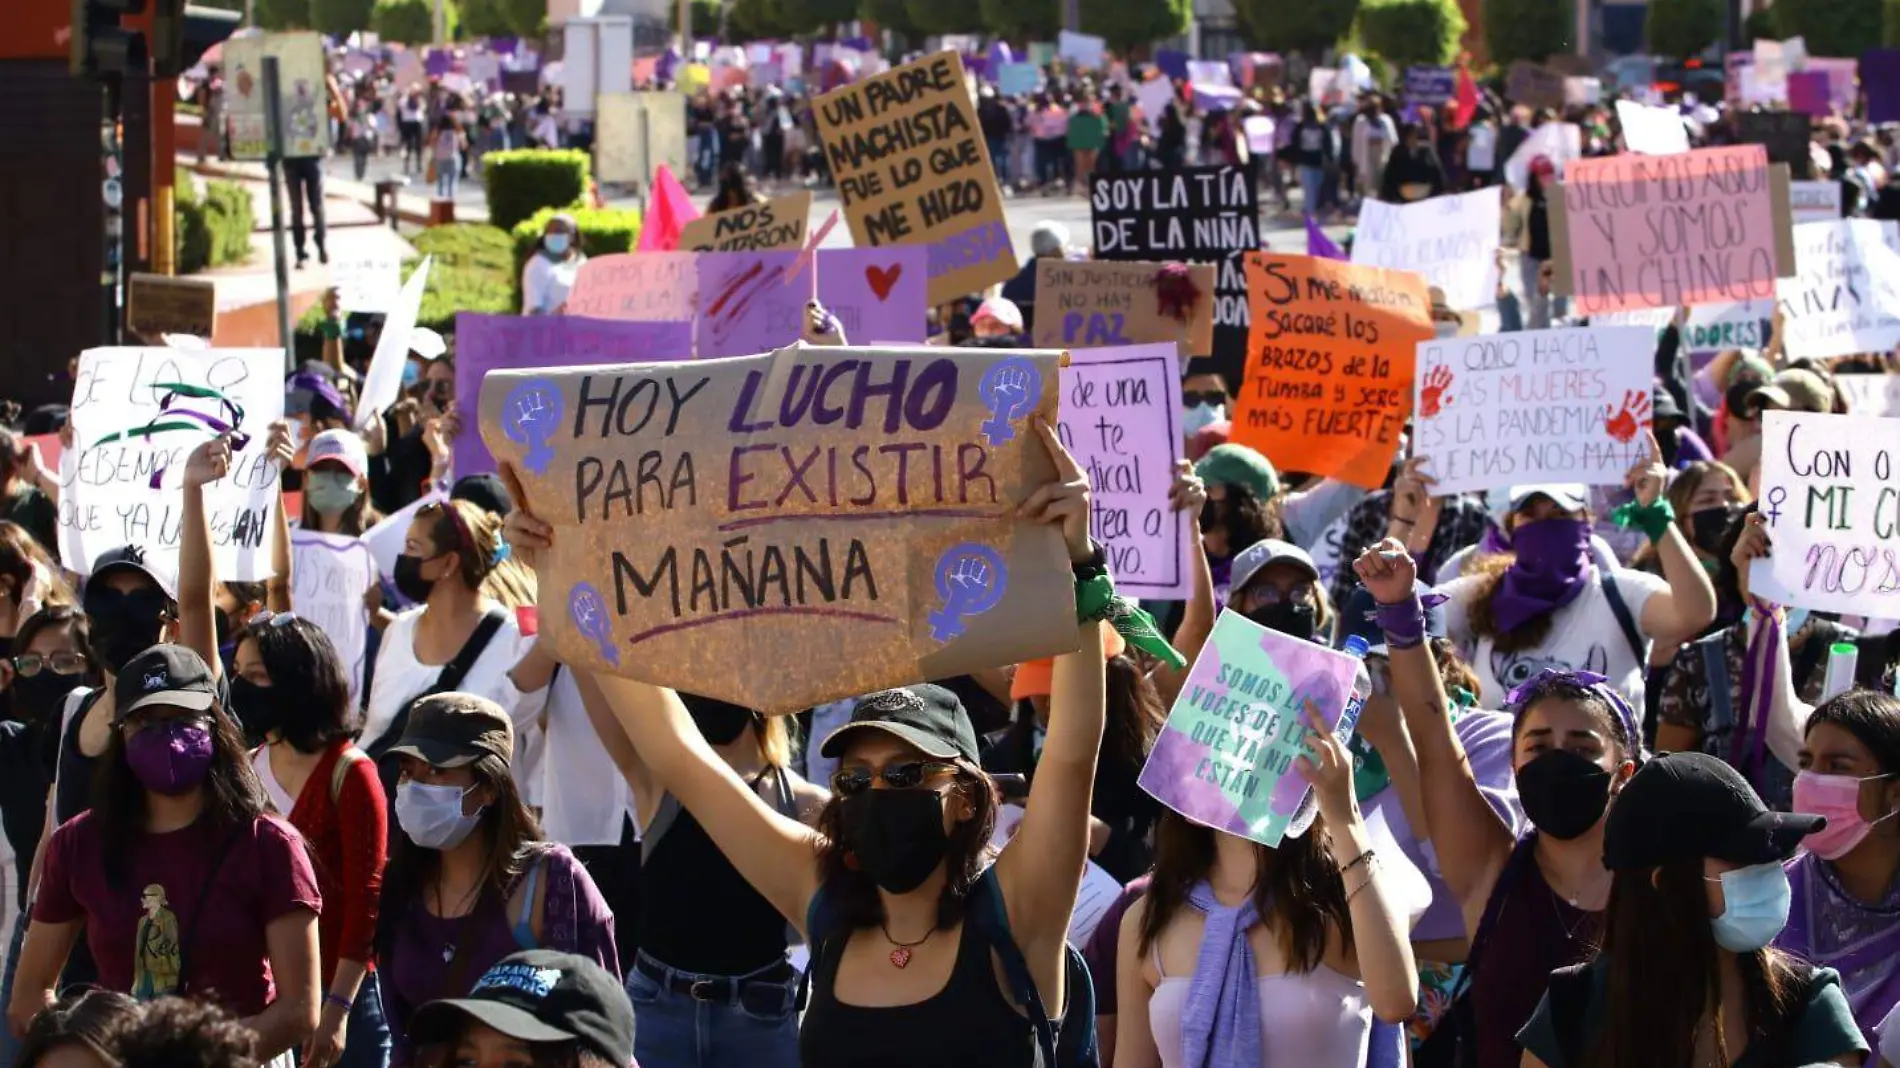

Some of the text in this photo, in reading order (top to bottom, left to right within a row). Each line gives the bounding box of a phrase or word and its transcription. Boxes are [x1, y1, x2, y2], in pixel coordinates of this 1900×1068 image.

[822, 59, 955, 127] UN PADRE
[828, 101, 970, 173] MACHISTA
[840, 138, 980, 207] FUE LO QUE
[1092, 166, 1249, 212] SOY LA TÍA
[715, 206, 774, 238] NOS
[864, 179, 984, 247] ME HIZO
[1096, 211, 1257, 252] DE LA NIÑA
[1591, 212, 1617, 260] Y
[1637, 200, 1748, 257] SOMOS
[1044, 267, 1074, 288] SIN
[1579, 262, 1626, 312] UN
[1637, 247, 1775, 306] CHINGO
[1059, 290, 1132, 310] NO HAY
[1063, 310, 1134, 345] PAZ
[1463, 339, 1521, 370] ODIO
[1533, 334, 1601, 365] HACIA
[573, 357, 959, 439] HOY LUCHO
[1071, 371, 1151, 409] de una
[1500, 368, 1608, 402] MUJERES
[1057, 415, 1128, 455] n te
[1456, 412, 1486, 444] LA
[1498, 405, 1608, 439] PANDEMIA
[1087, 455, 1142, 494] dical
[1430, 448, 1461, 481] UE
[1469, 444, 1516, 478] MAS
[1525, 442, 1576, 473] NOS
[576, 442, 998, 523] PARA EXISTIR
[115, 502, 151, 541] YA
[1804, 483, 1855, 530] MI
[612, 535, 878, 618] MAÑANA
[1104, 543, 1145, 576] ivo.
[1216, 663, 1283, 702] SOMOS
[1189, 686, 1250, 724] VOCES
[1254, 709, 1282, 737] DE
[1191, 721, 1293, 777] QUE YA NO
